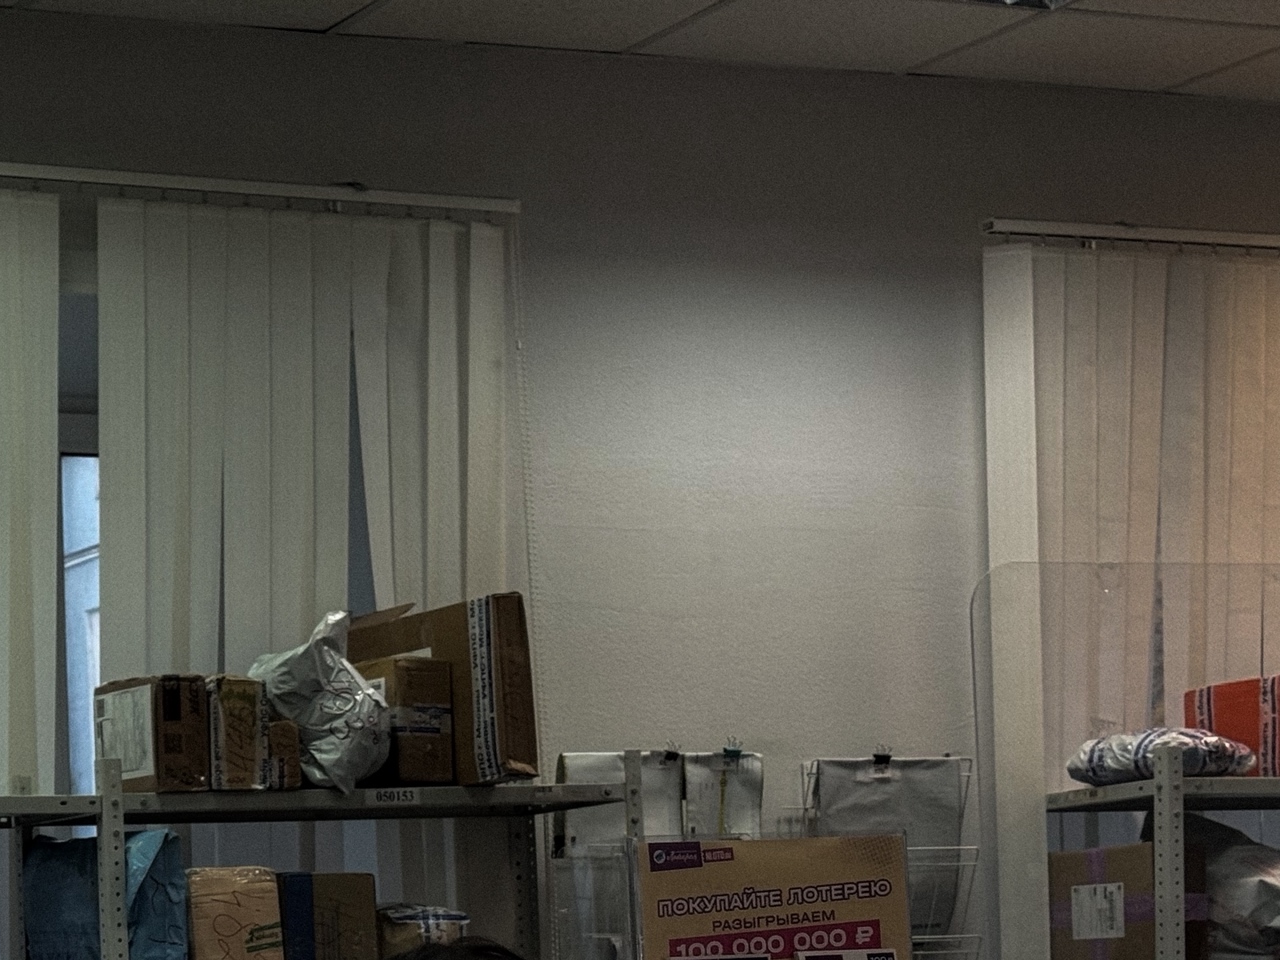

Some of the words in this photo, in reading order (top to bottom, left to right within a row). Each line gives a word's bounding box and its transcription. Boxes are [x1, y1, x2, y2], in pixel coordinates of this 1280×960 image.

[376, 789, 414, 803] 050153
[657, 886, 782, 917] ПОКУПАЙТЕ
[787, 879, 892, 905] ЛОТЕРЕЮ
[712, 910, 835, 932] РАЗЫГРЫВАЕМ
[676, 940, 723, 957] 100
[732, 934, 785, 956] 000
[793, 928, 847, 950] 000
